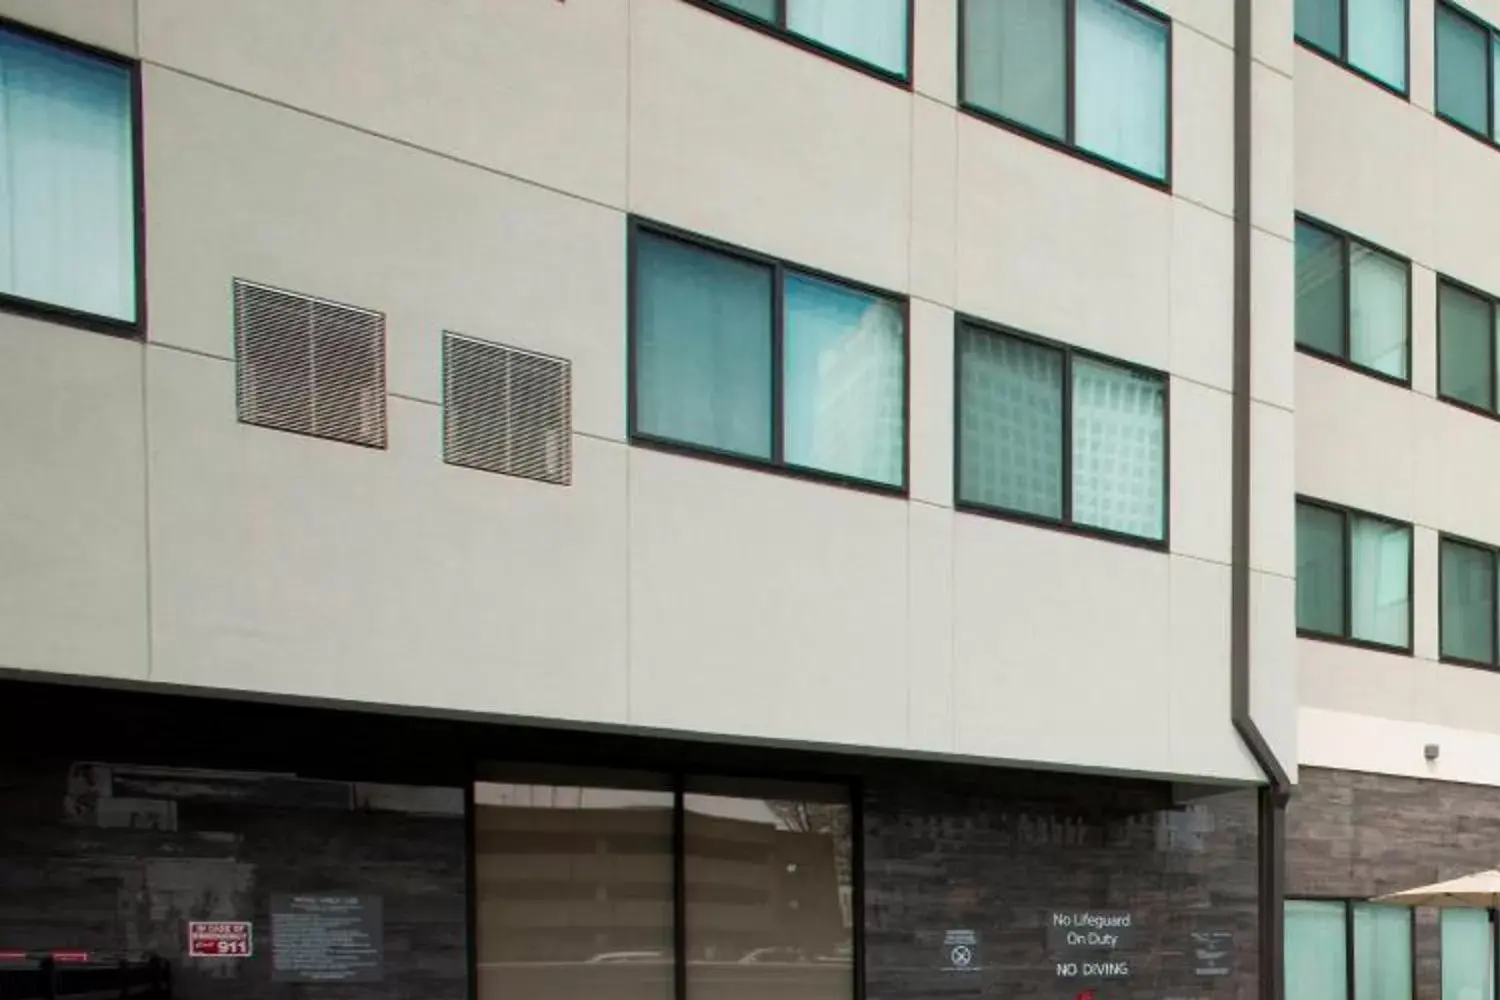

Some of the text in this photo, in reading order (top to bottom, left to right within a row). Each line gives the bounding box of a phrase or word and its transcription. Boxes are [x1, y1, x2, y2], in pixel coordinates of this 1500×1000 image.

[1053, 911, 1131, 929] No Lifeguard
[217, 940, 247, 953] 911
[1066, 931, 1119, 949] On Duty
[1056, 961, 1130, 976] NO DIVING
